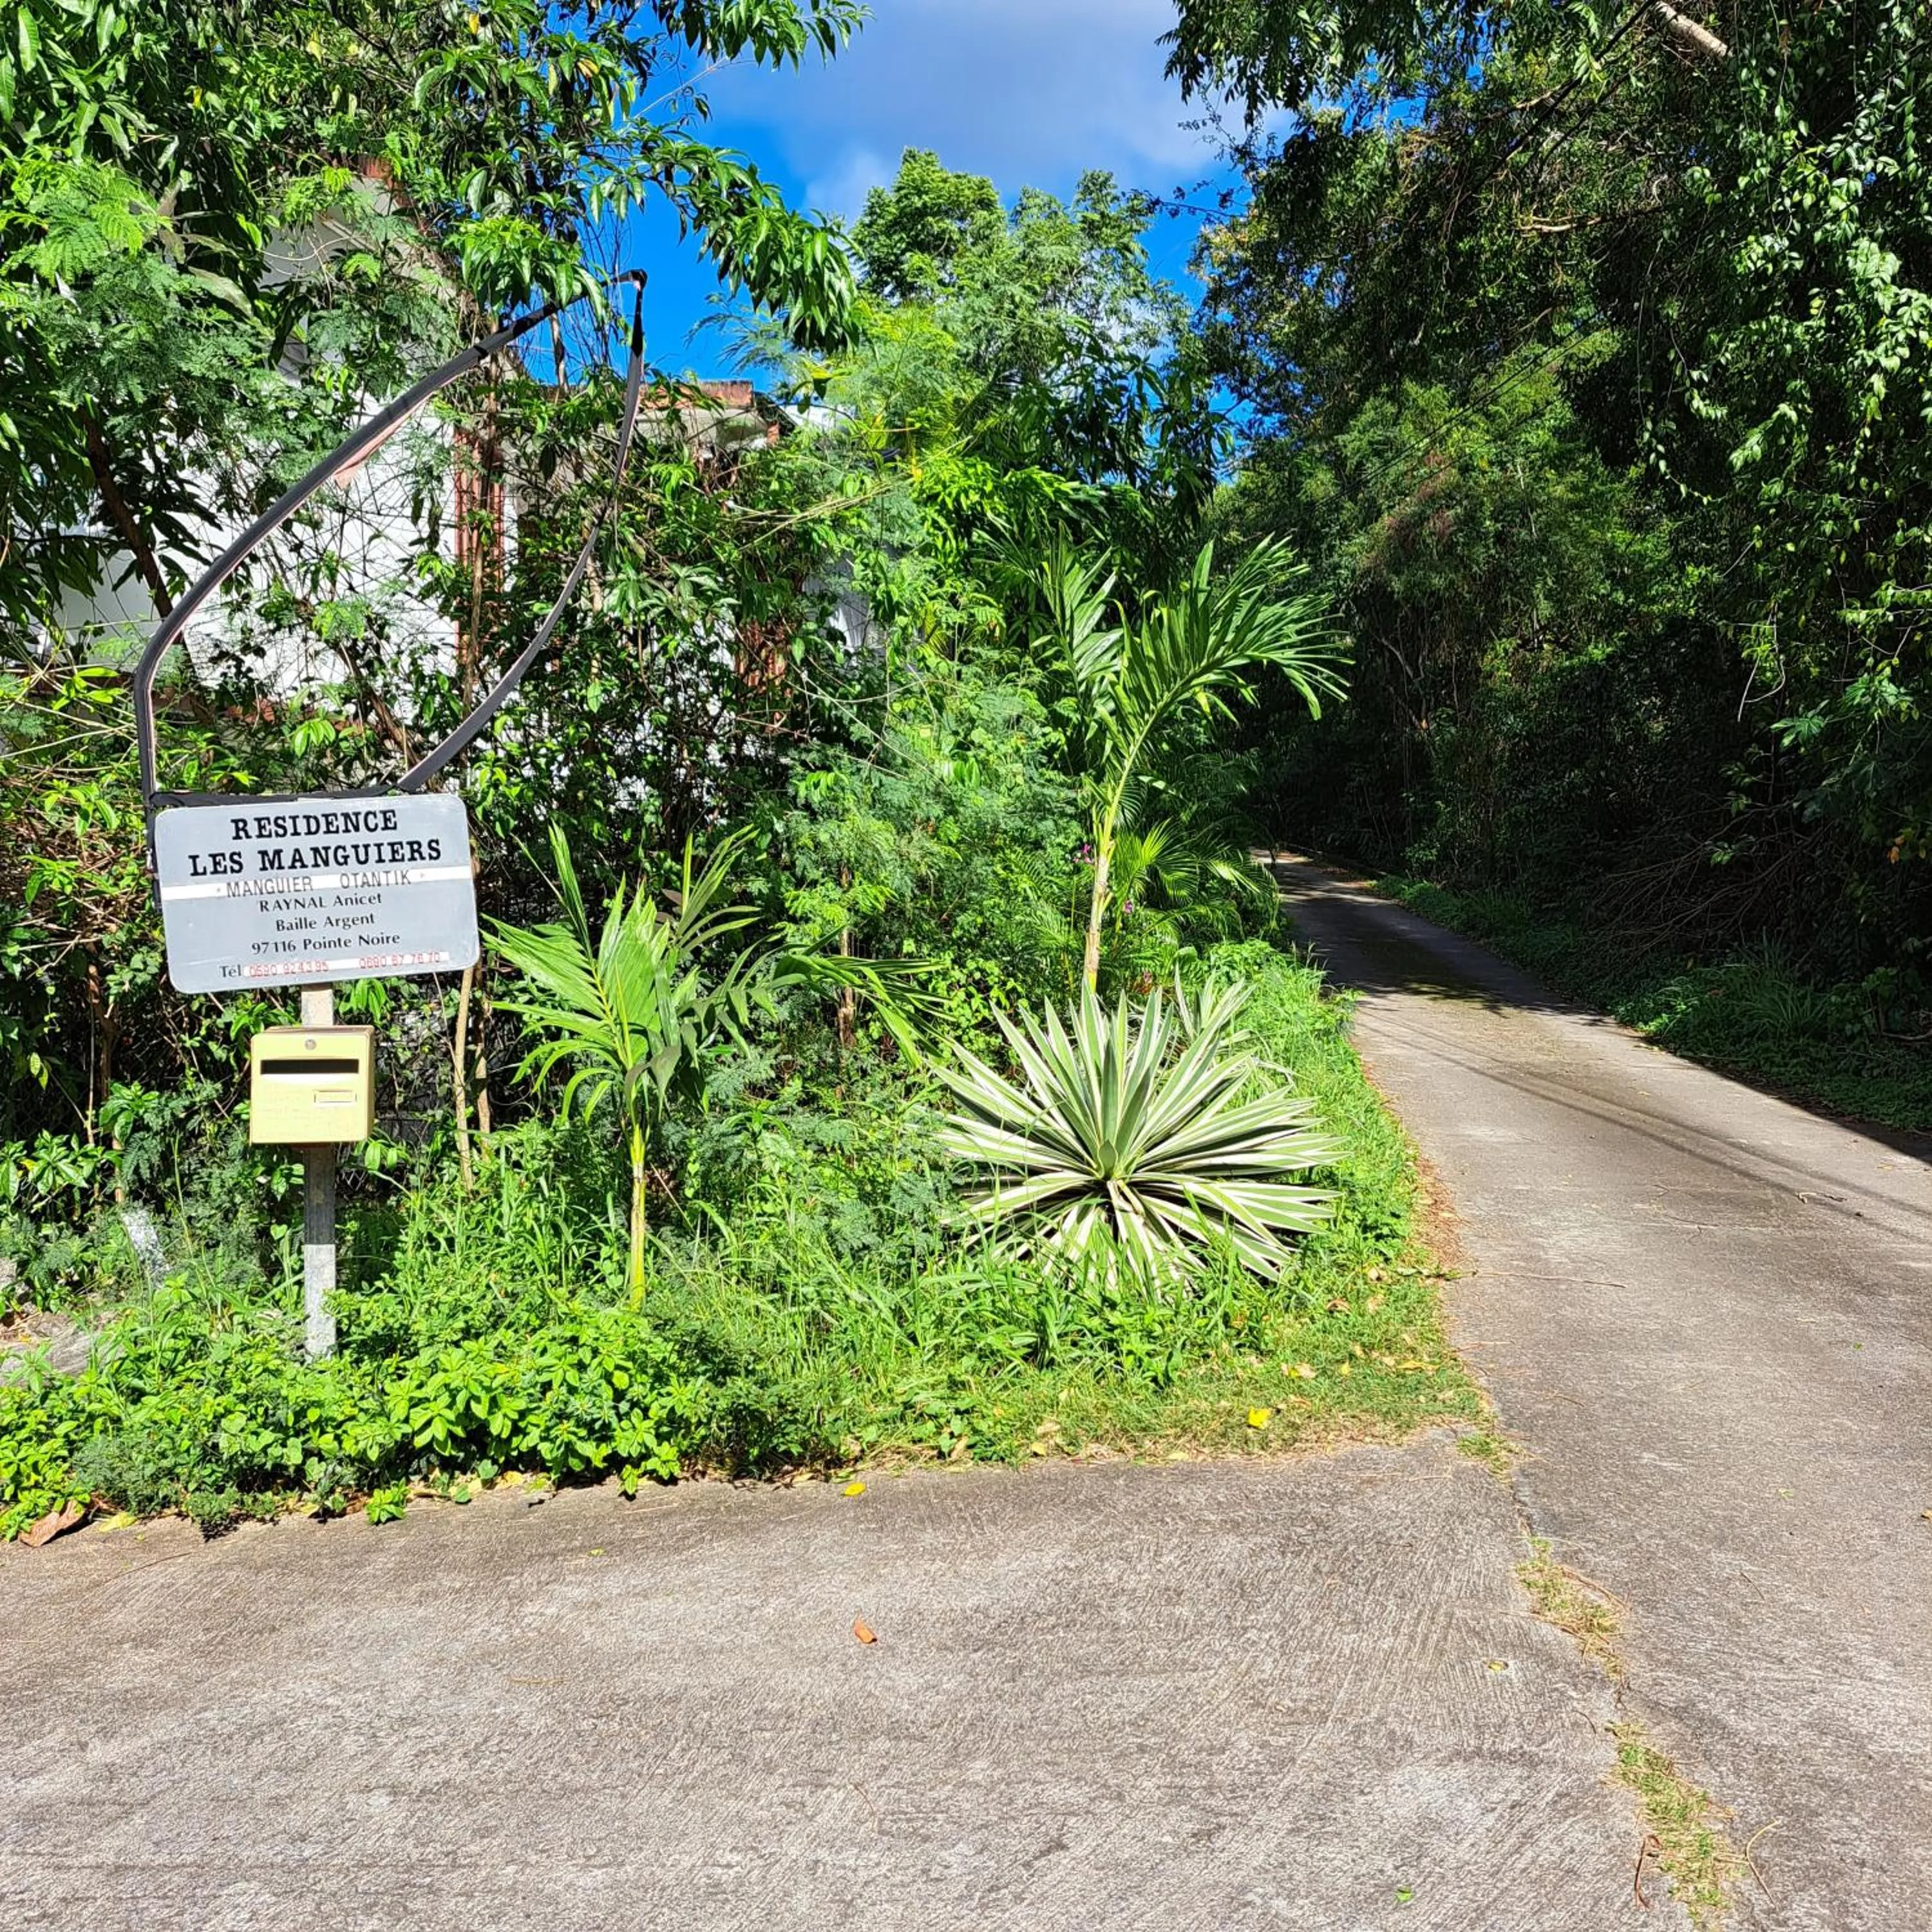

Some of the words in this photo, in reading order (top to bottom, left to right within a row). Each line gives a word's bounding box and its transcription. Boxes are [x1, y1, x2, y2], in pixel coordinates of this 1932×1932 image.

[231, 809, 398, 840] RESIDENCE
[188, 850, 244, 876] LES
[258, 838, 442, 871] MANGUIERS
[226, 875, 314, 898] MANGUIER
[339, 869, 412, 889] OTANTIK
[259, 896, 327, 913] RAYNAL
[332, 893, 383, 907] Anicet
[276, 916, 317, 932] Baille
[323, 913, 375, 930] Argent
[251, 940, 296, 954] 97116
[302, 936, 352, 951] Pointe
[358, 932, 401, 947] Noire
